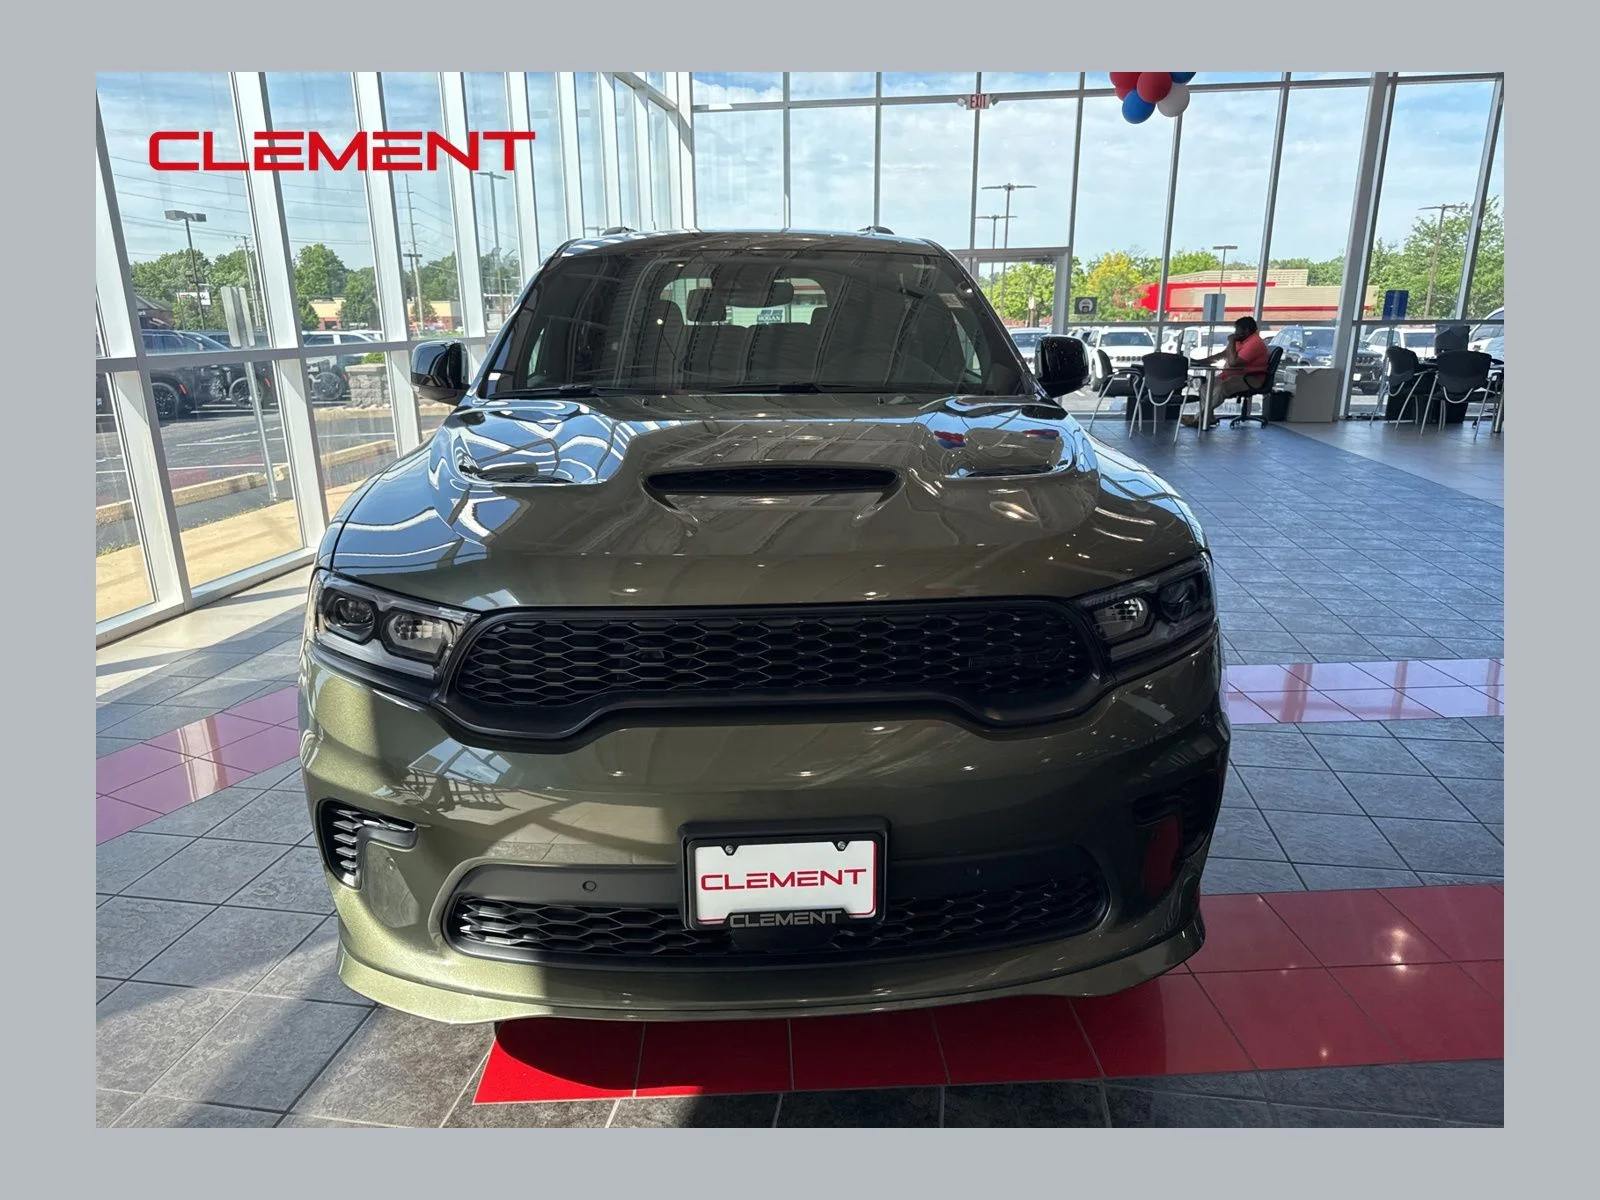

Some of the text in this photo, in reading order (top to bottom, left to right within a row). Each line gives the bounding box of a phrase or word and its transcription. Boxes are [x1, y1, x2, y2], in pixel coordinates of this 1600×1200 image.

[970, 94, 987, 108] EXIT
[701, 868, 867, 890] CLEMENT
[730, 911, 842, 928] CLEMENT
